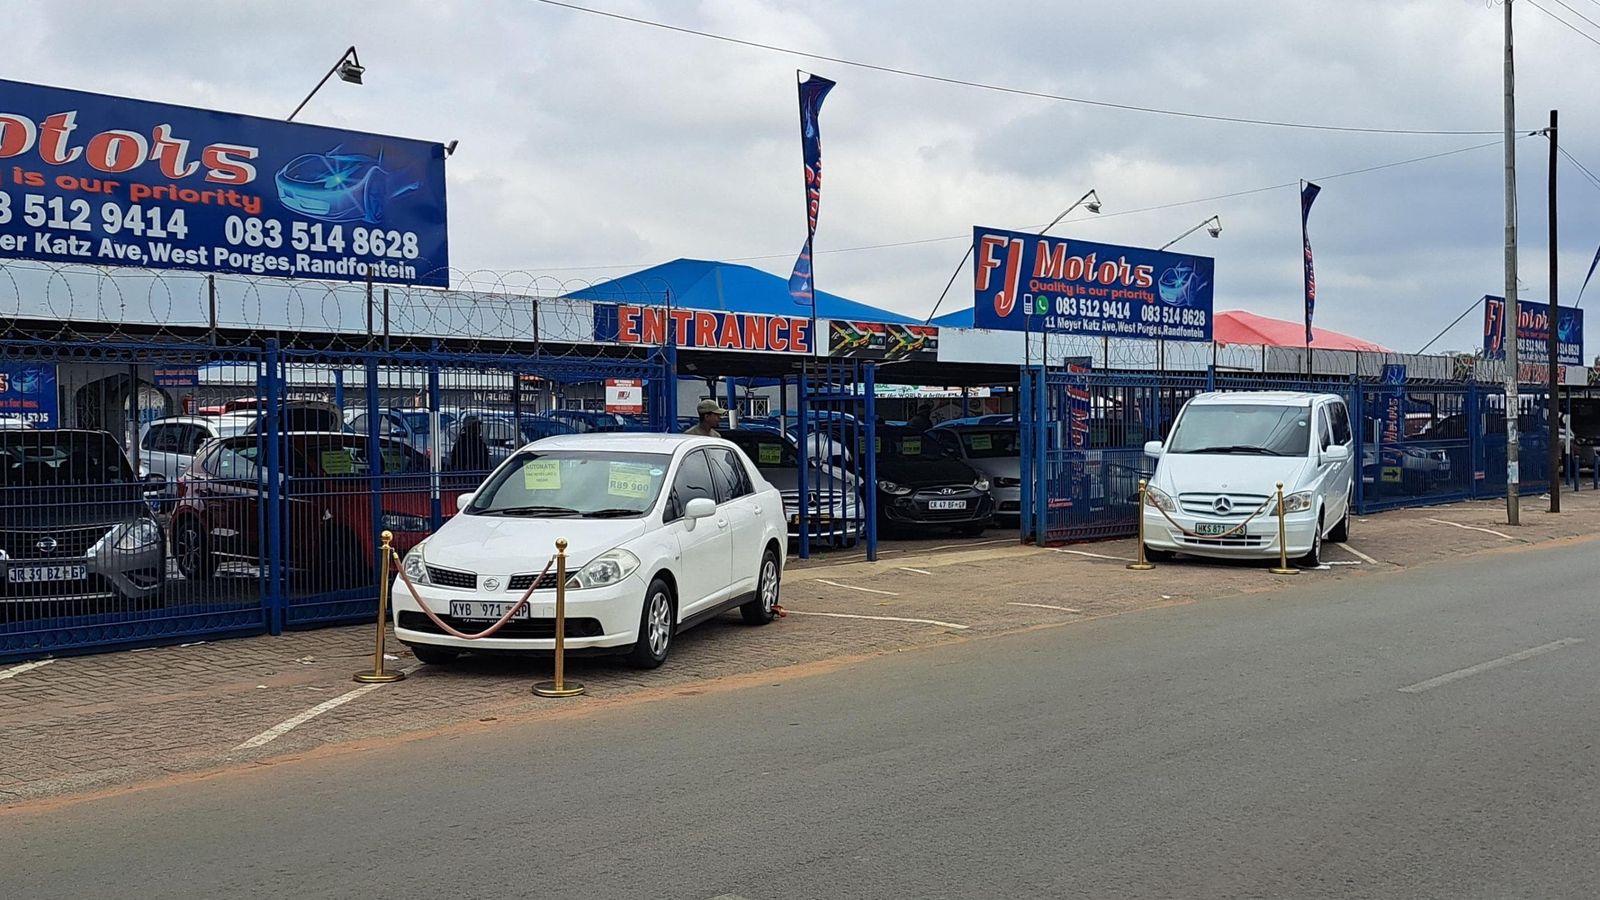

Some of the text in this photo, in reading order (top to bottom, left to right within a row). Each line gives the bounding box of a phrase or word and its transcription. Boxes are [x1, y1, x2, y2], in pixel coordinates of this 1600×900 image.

[12, 166, 263, 215] is our priority
[23, 194, 92, 231] 512
[101, 202, 188, 239] 9414
[225, 215, 283, 249] 083
[291, 222, 346, 253] 514
[352, 227, 419, 260] 8628
[34, 232, 92, 257] Katz
[98, 238, 208, 265] Ave,West
[214, 247, 416, 280] Porges,Randfontein
[975, 234, 1154, 318] FJ Motors
[1029, 279, 1155, 304] Quality is our priority
[1045, 316, 1056, 328] 11
[1057, 318, 1081, 332] Meyer
[1082, 319, 1100, 332] Katz
[1055, 296, 1206, 327] 083 512 9414 083 514 8628
[1484, 300, 1505, 353] FJ
[617, 306, 810, 352] ENTRANCE
[610, 480, 649, 492] R89 900
[1198, 524, 1211, 533] HKS
[72, 566, 86, 579] GP
[452, 603, 472, 616] XYB
[481, 604, 502, 617] 971
